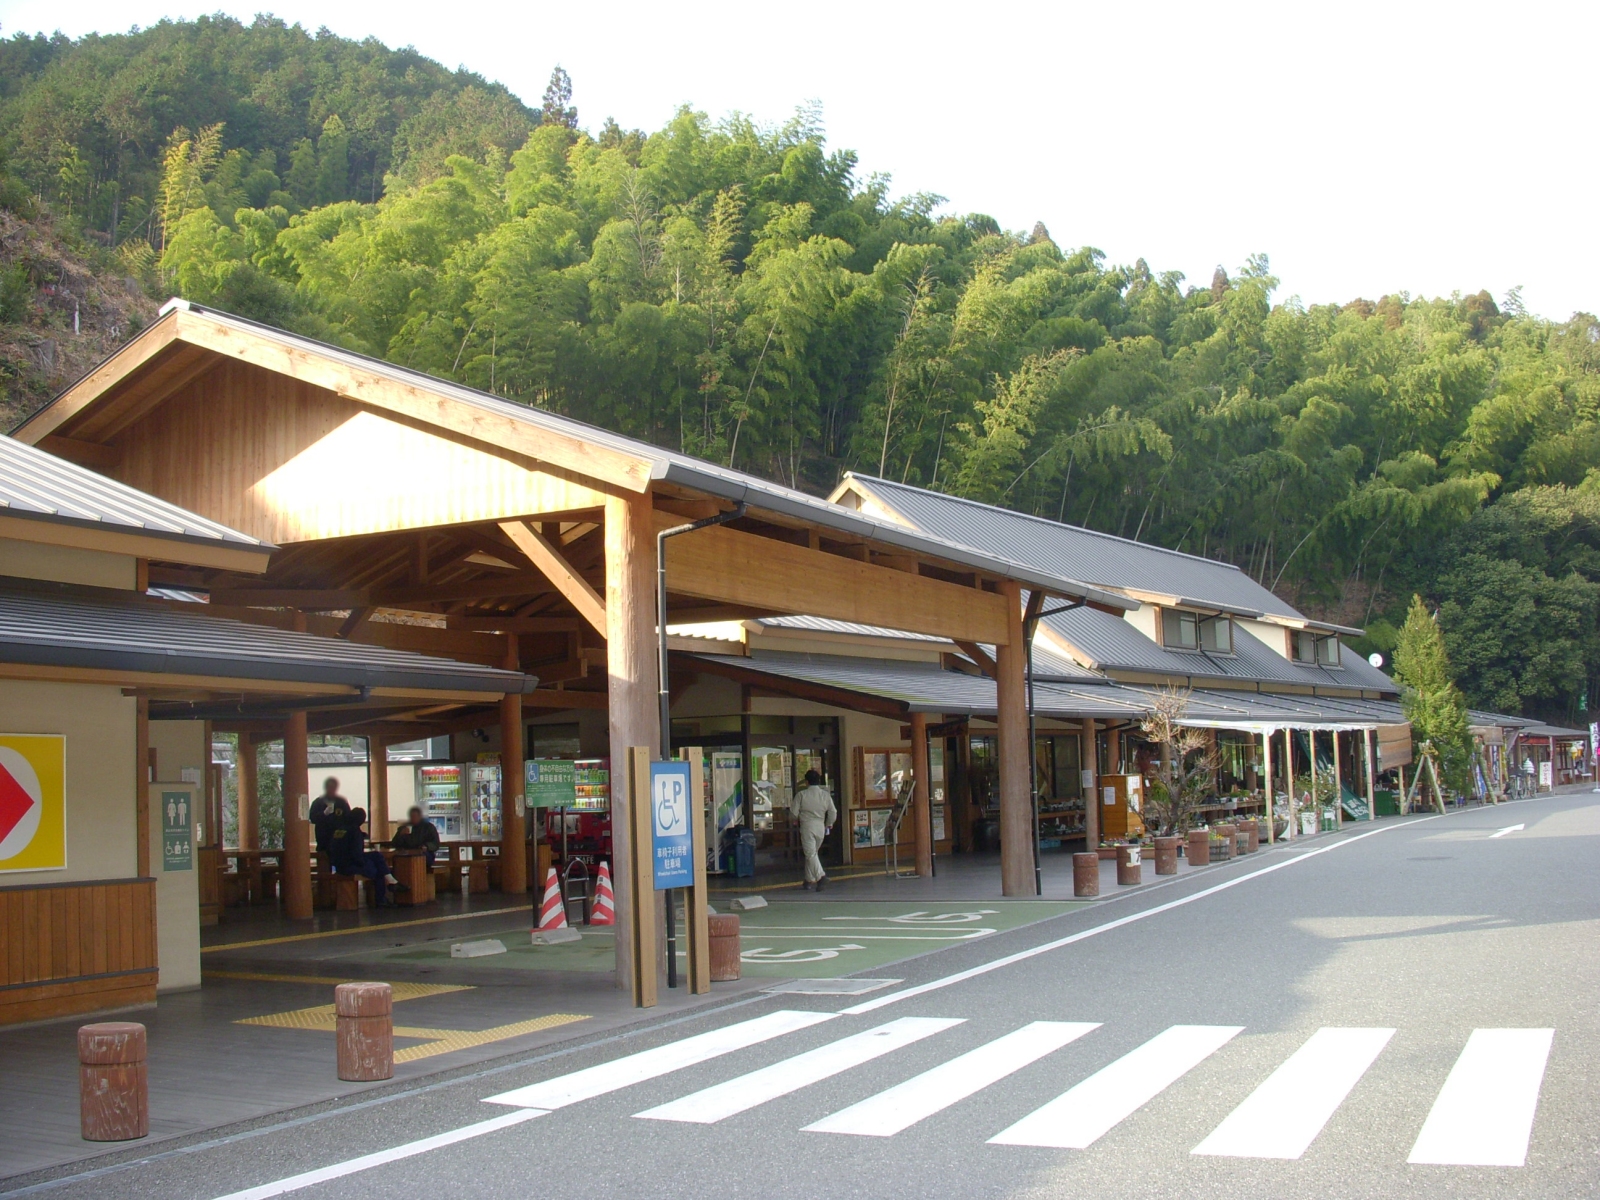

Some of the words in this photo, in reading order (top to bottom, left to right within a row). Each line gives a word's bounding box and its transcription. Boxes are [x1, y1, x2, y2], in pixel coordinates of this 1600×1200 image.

[672, 781, 682, 804] P
[657, 846, 687, 858] 車椅子利用者
[664, 858, 681, 869] 駐車場
